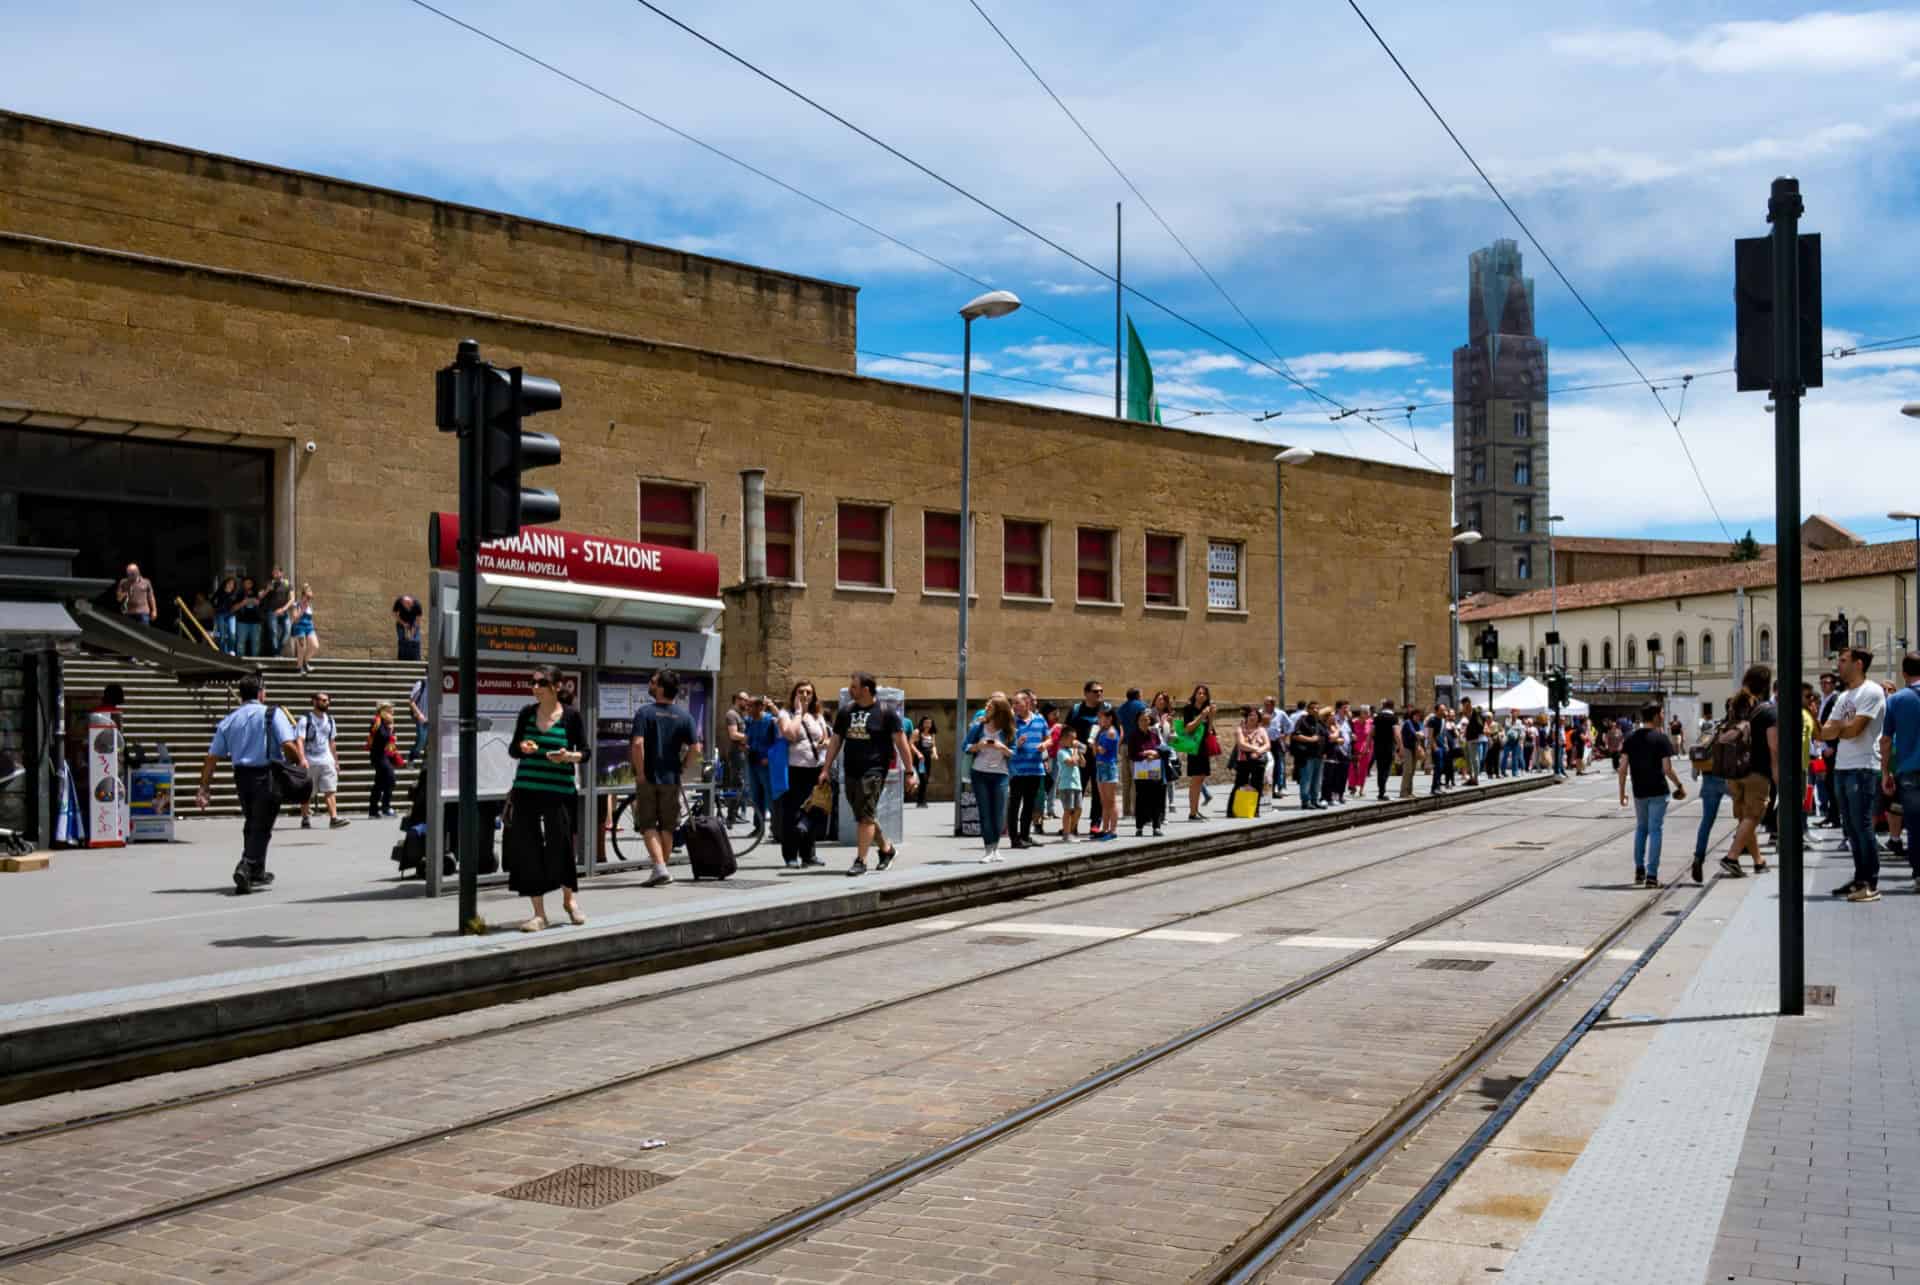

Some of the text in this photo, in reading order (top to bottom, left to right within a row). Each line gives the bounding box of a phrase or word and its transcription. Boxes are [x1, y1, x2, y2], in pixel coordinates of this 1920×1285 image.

[477, 554, 568, 576] NTA MARIA NOVELLA
[480, 531, 565, 559] AMANNI
[583, 540, 662, 571] STAZIONE
